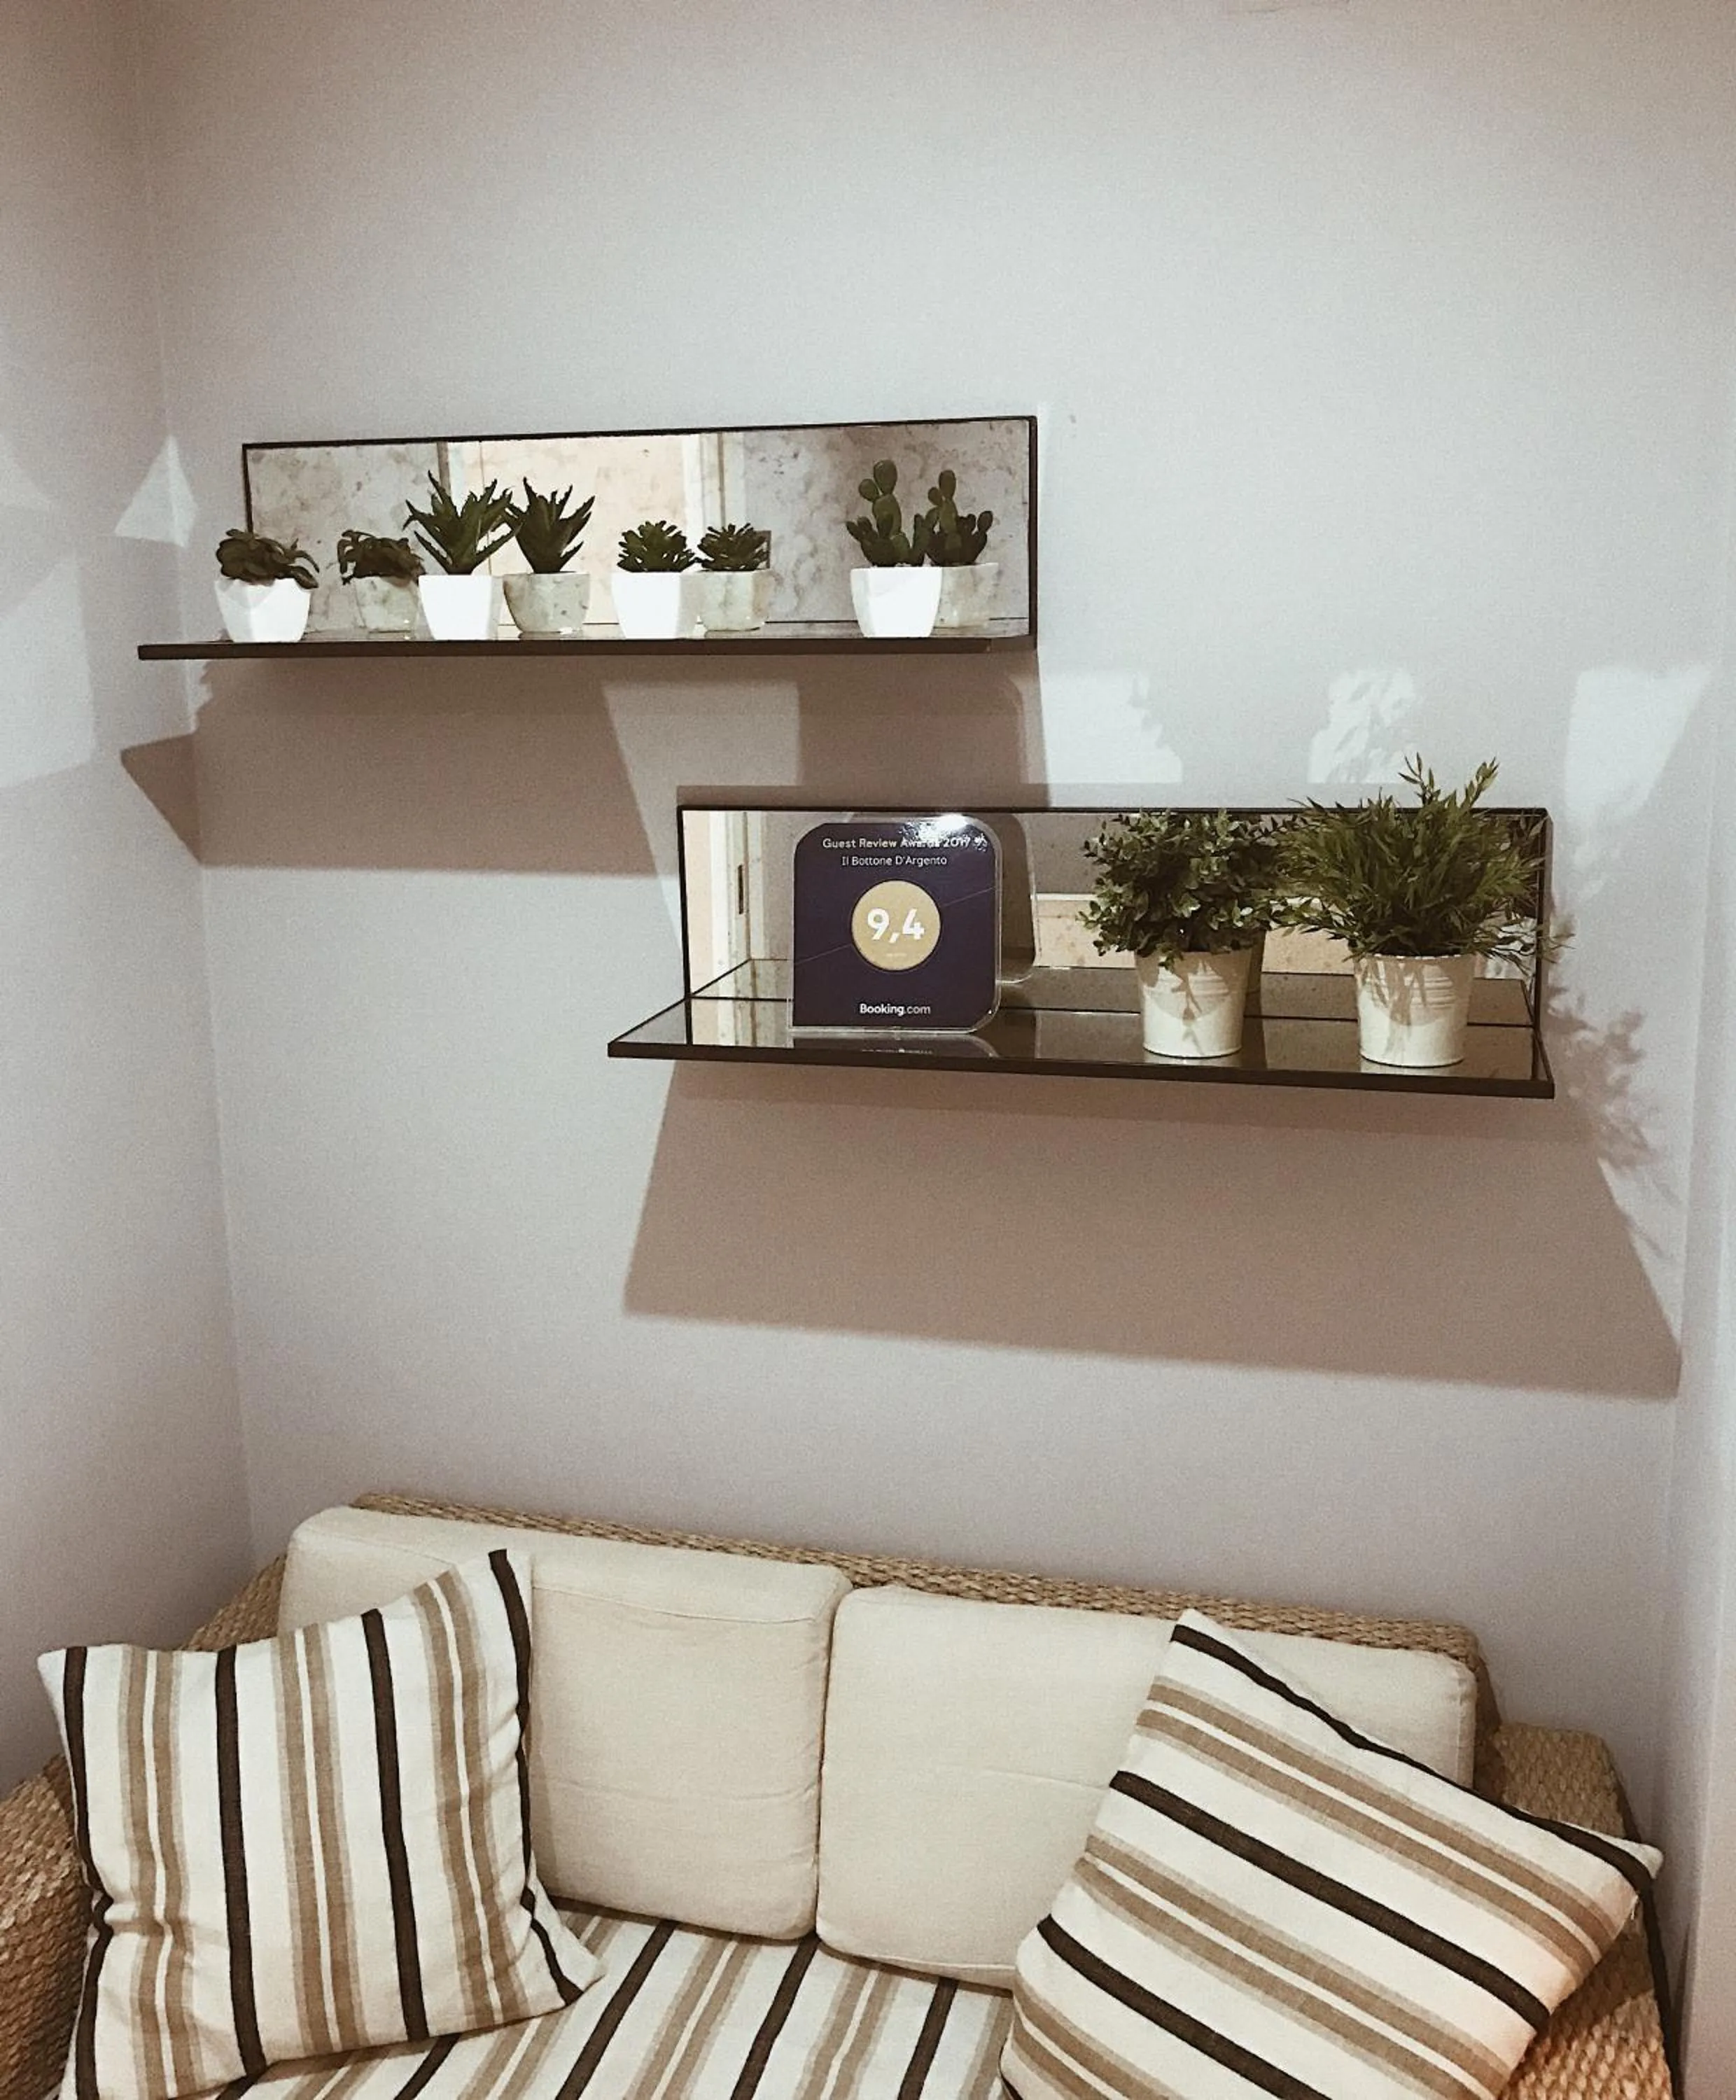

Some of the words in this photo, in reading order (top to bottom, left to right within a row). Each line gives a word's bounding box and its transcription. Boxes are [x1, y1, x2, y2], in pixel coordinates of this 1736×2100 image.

[822, 838, 856, 848] Guest
[859, 838, 897, 848] Review
[852, 856, 892, 867] Bottone
[895, 855, 948, 867] D'Argento
[867, 907, 925, 944] 9,4
[859, 1003, 931, 1016] Booking.com
